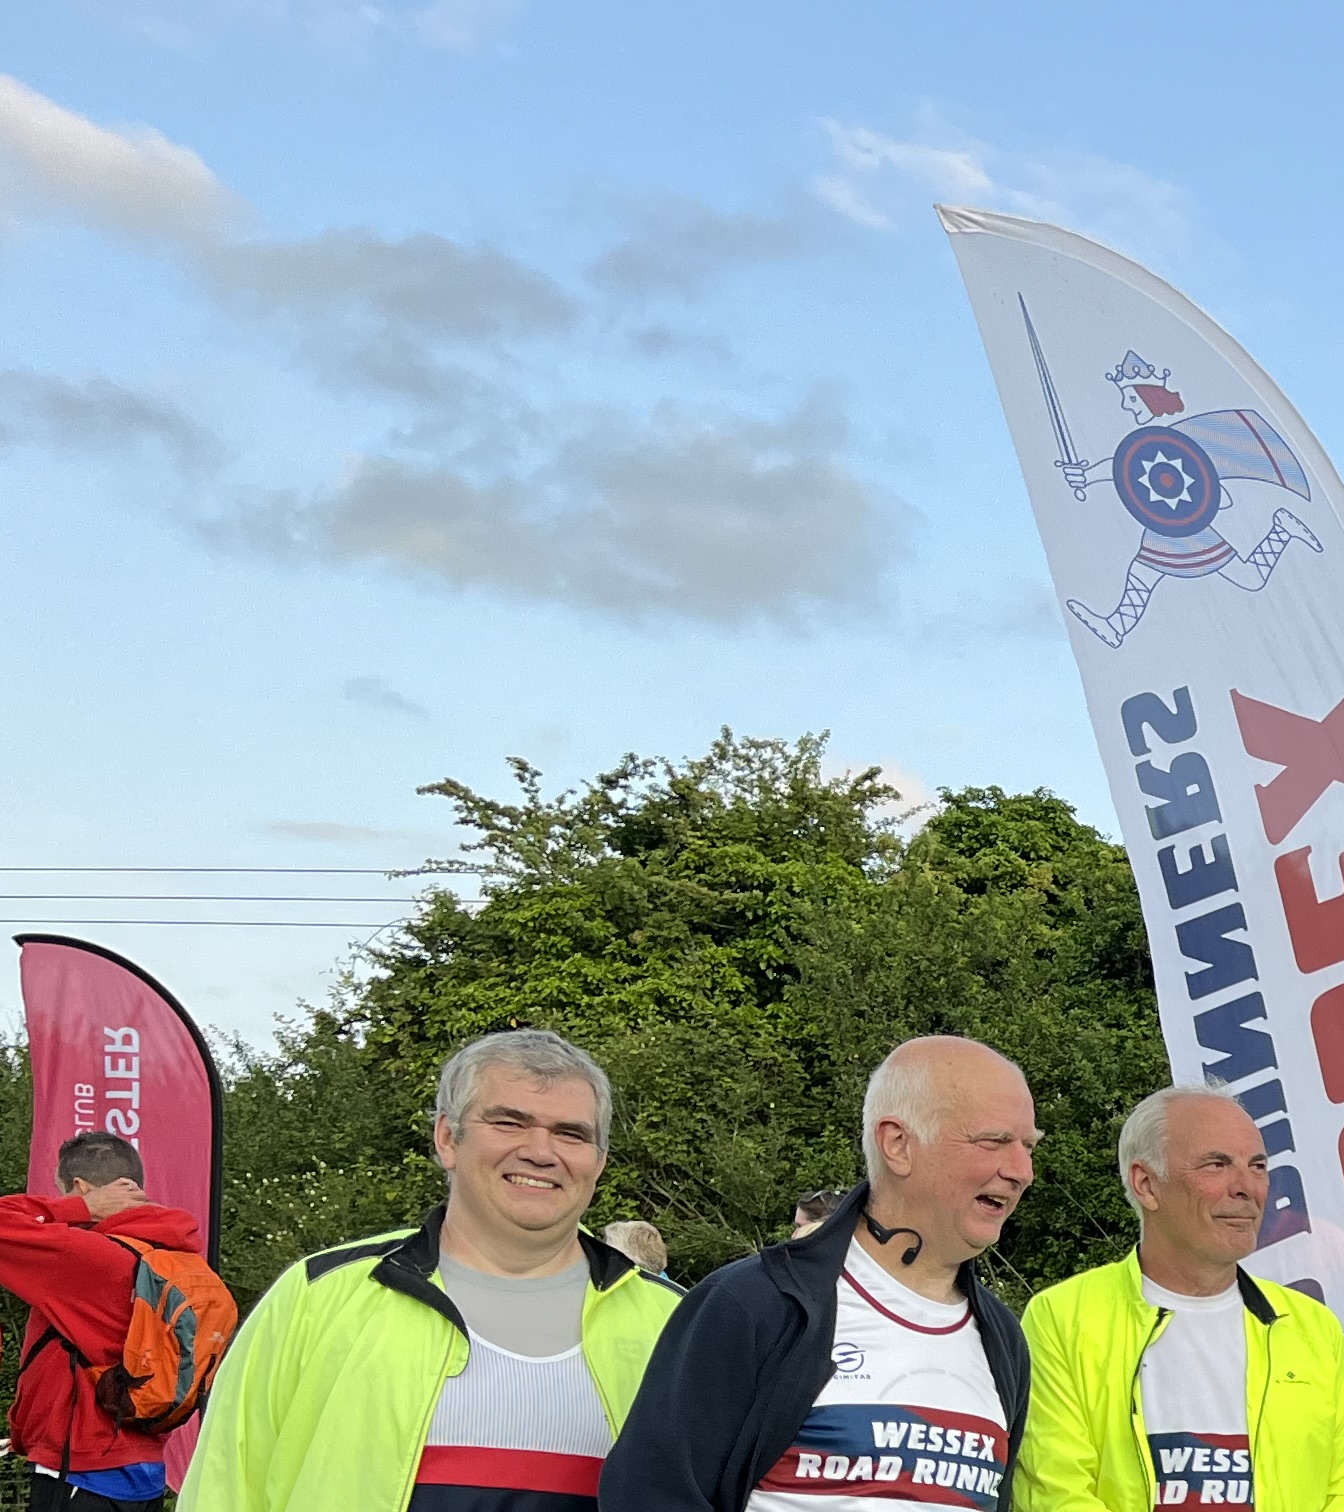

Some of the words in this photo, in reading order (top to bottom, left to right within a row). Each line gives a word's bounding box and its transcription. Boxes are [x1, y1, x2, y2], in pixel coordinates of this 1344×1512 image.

[871, 1420, 996, 1463] WESSEX
[1158, 1446, 1250, 1474] WESS
[795, 1453, 904, 1482] ROAD
[911, 1457, 1004, 1498] RUNNE
